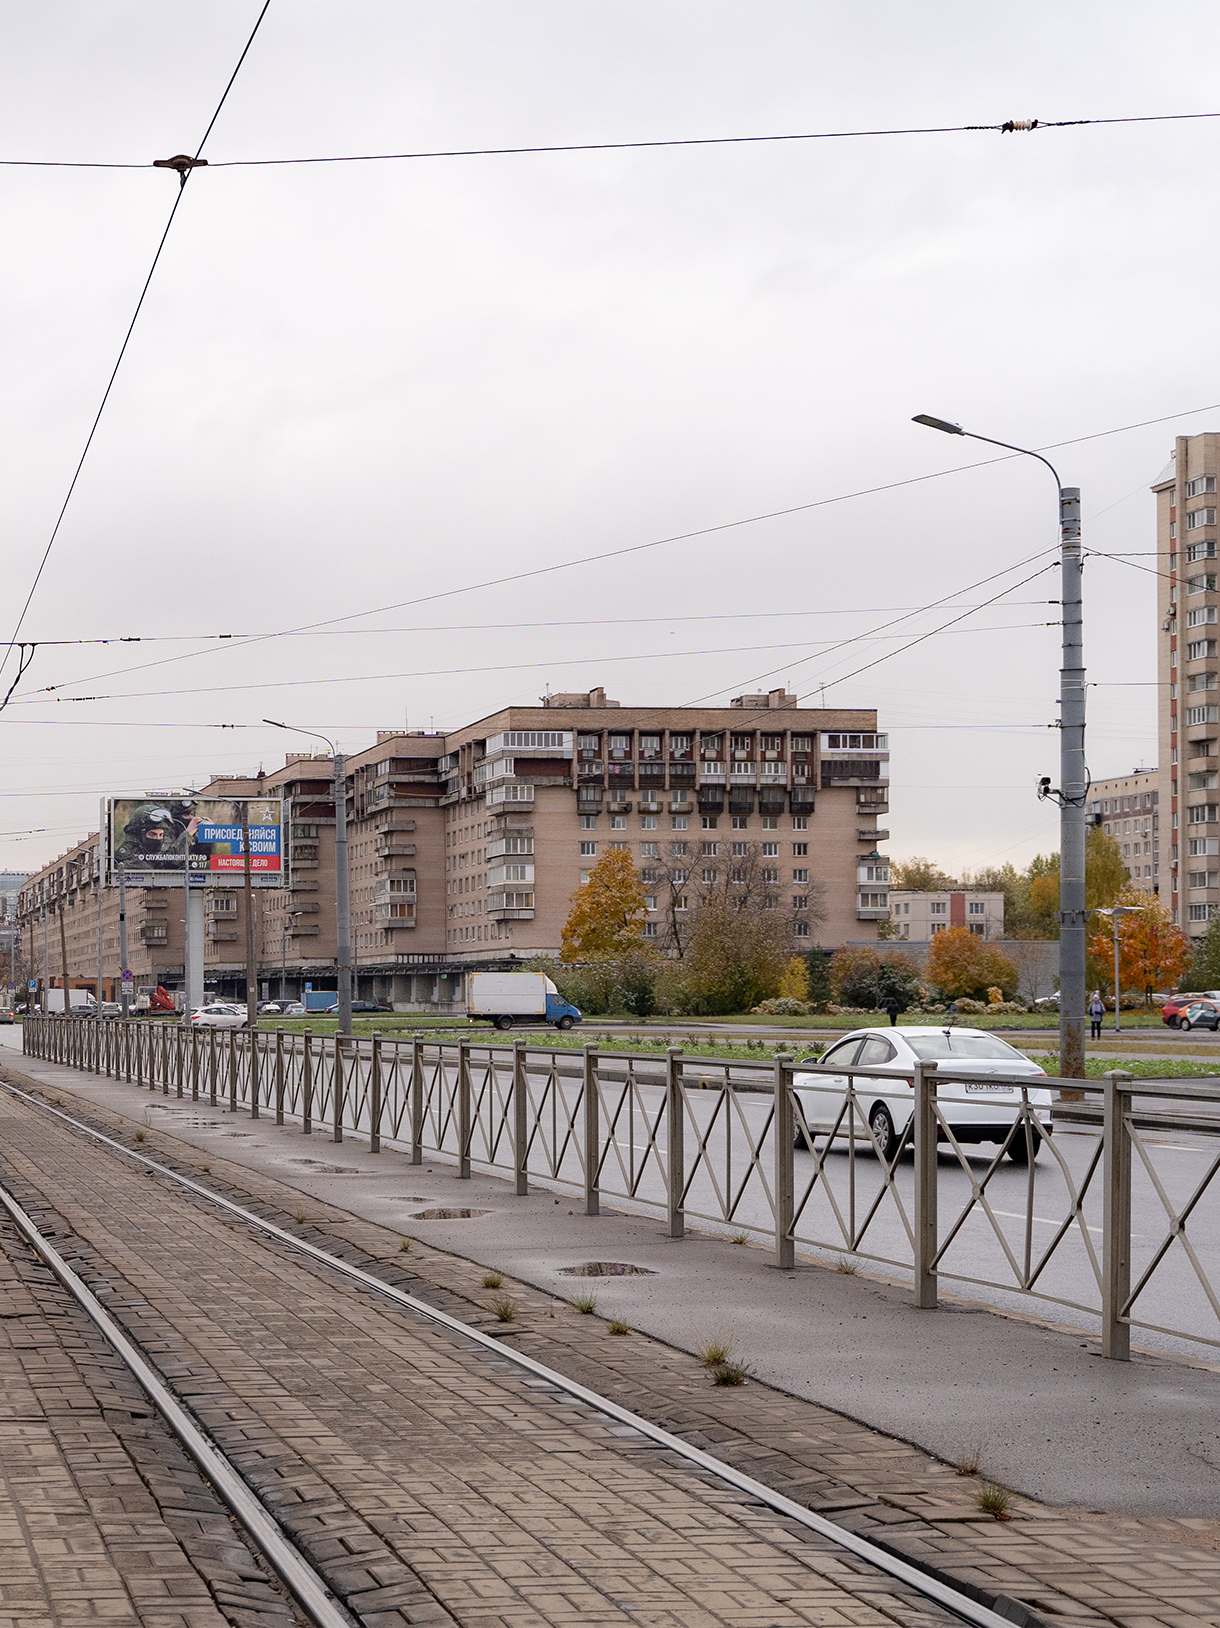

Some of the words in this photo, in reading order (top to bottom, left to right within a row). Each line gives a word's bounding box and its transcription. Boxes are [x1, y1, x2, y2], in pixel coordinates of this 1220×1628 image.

[204, 826, 276, 841] ПРИСОЕДНЯЙСЯ
[248, 841, 276, 853] СВОИМ
[218, 858, 252, 868] НАСТОЯЩЕ
[252, 858, 268, 868] ДЕЛО
